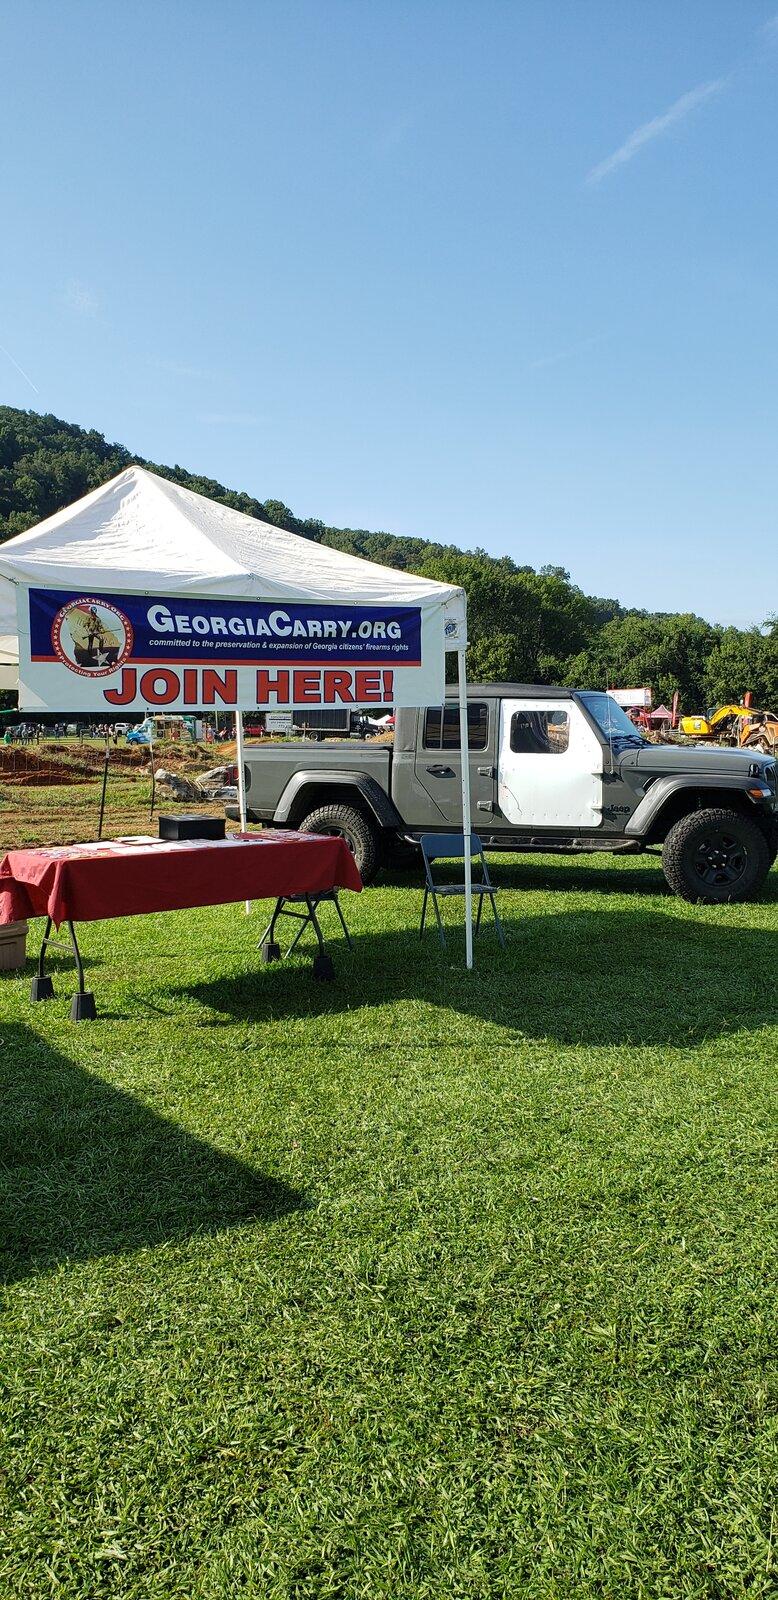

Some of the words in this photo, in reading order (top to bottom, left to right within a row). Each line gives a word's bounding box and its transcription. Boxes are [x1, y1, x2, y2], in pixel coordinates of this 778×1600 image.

[149, 639, 191, 647] committed
[215, 640, 260, 649] preservation
[269, 642, 303, 651] expansion
[304, 642, 312, 650] of
[312, 643, 338, 652] Georgia
[366, 643, 391, 651] firearms
[391, 644, 409, 652] rights
[103, 668, 238, 705] JOIN
[256, 669, 394, 703] HERE!
[608, 804, 631, 813] Jeep
